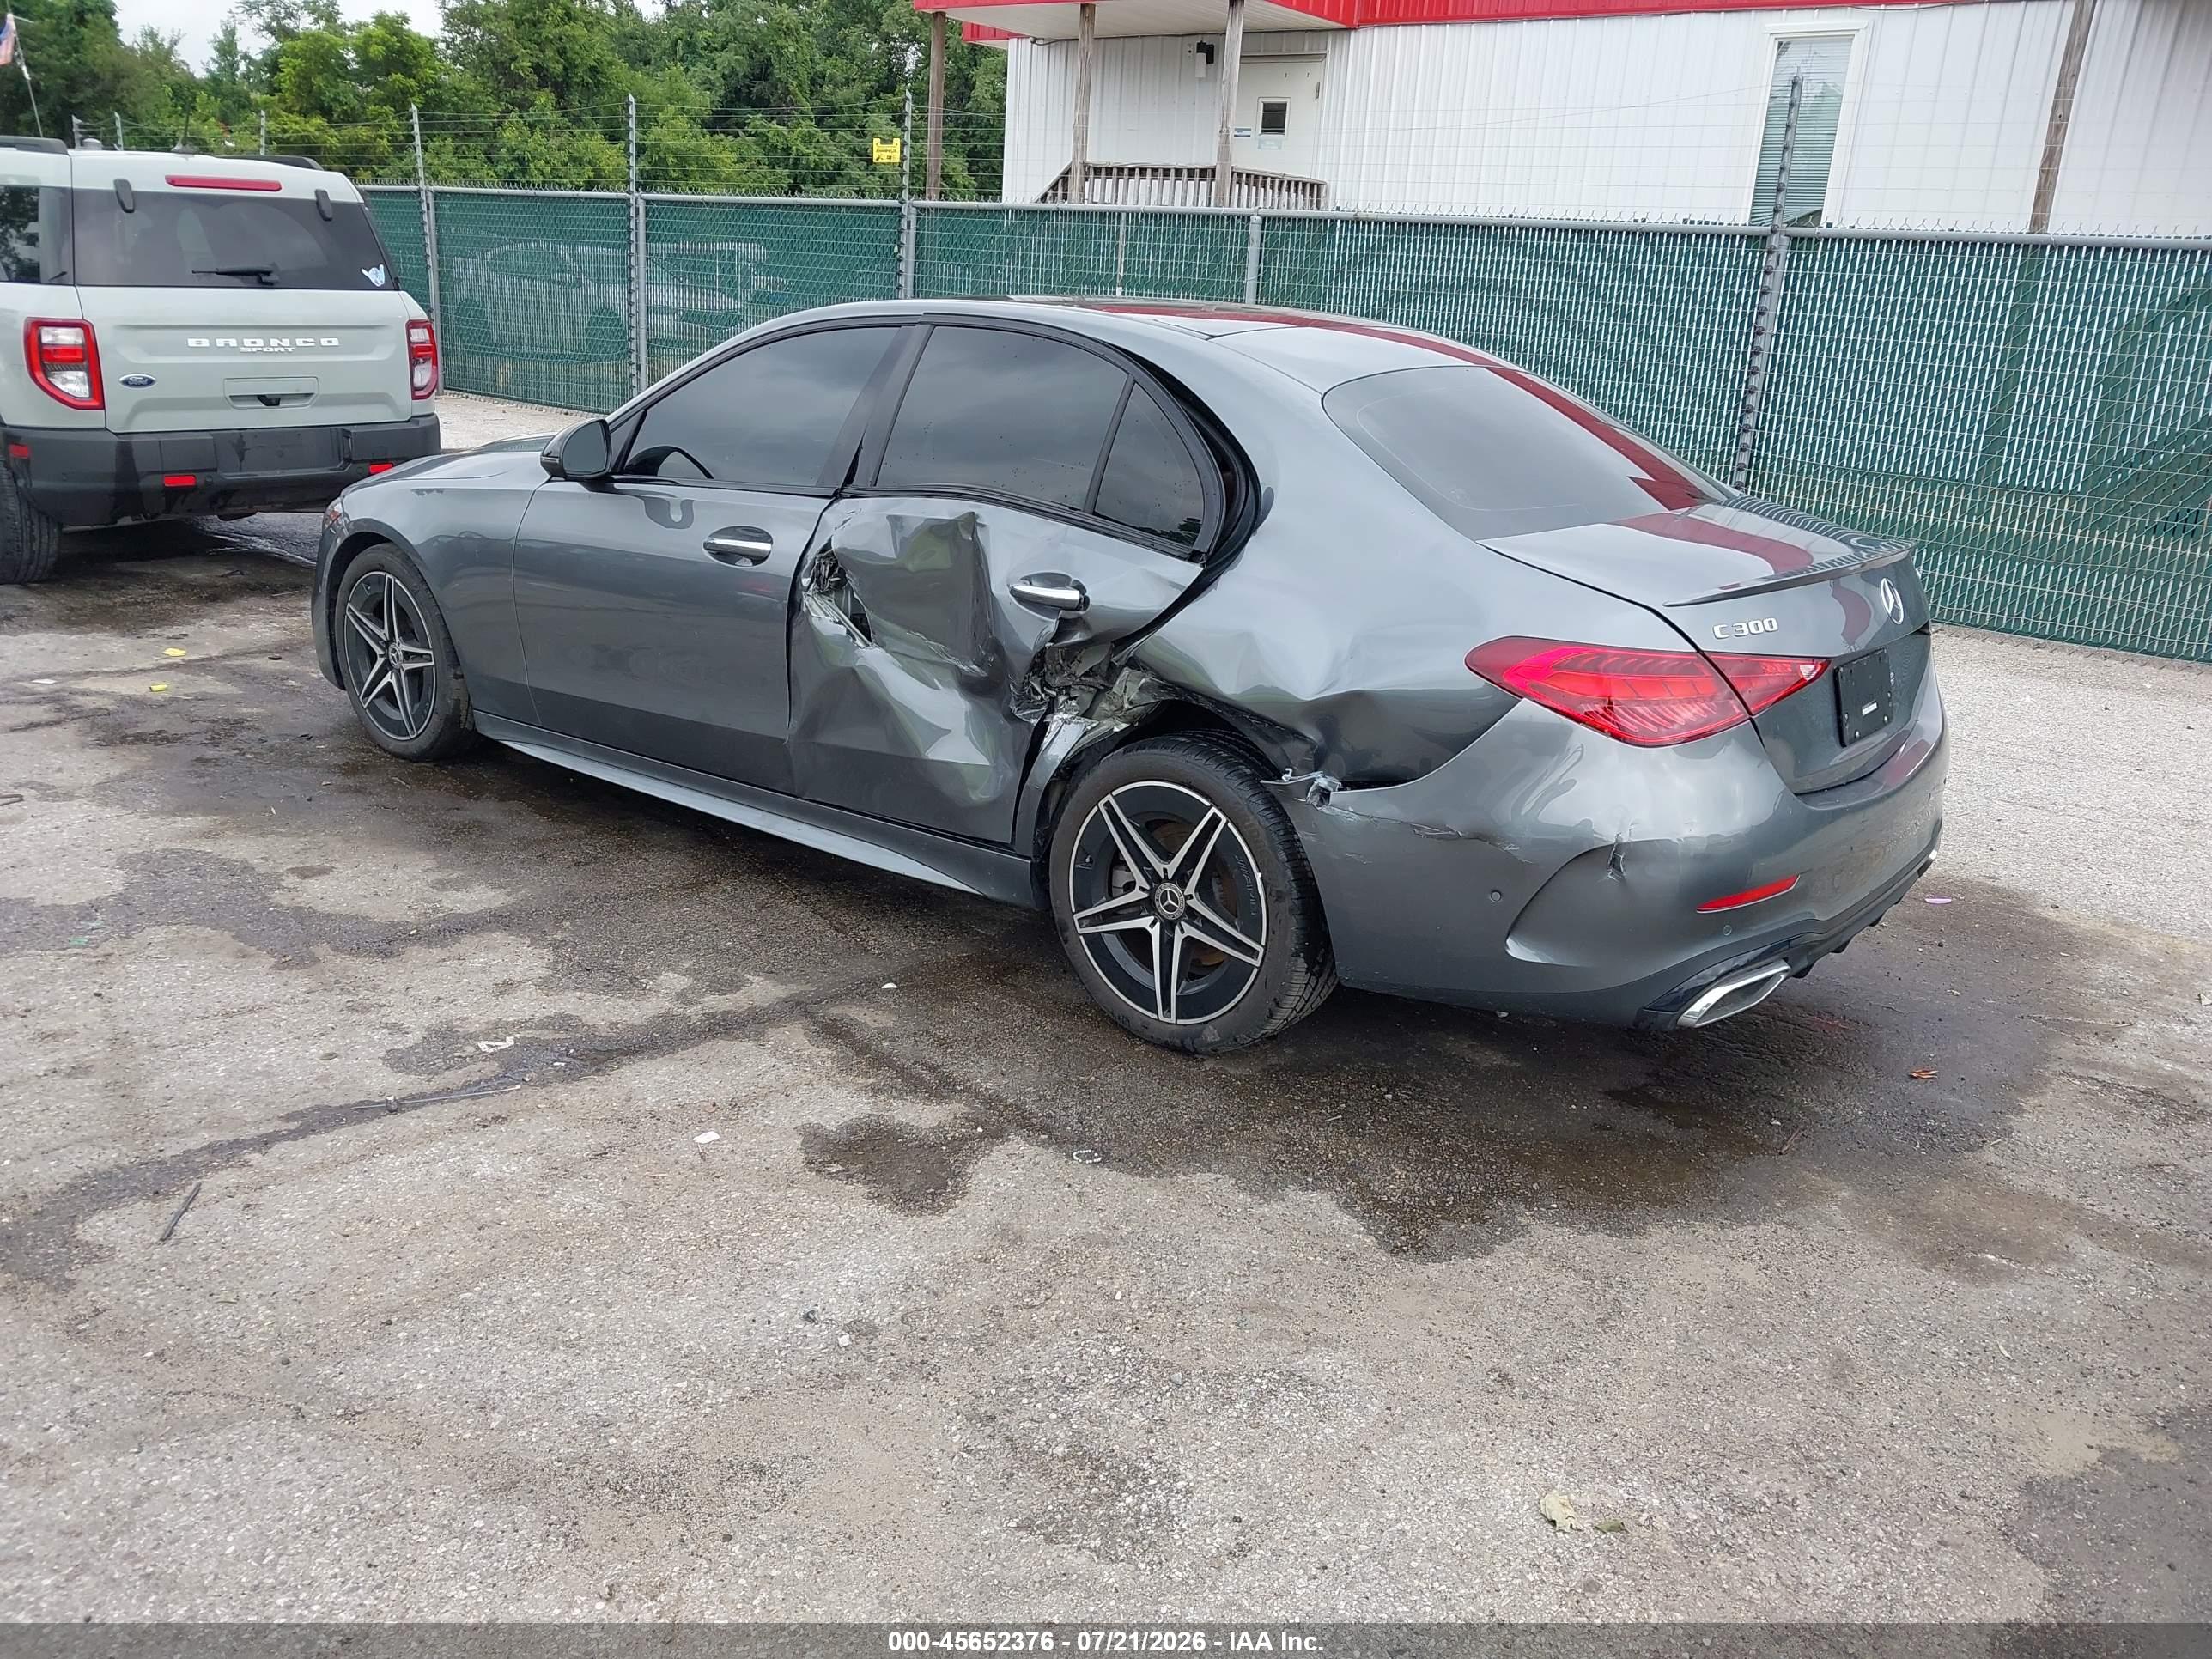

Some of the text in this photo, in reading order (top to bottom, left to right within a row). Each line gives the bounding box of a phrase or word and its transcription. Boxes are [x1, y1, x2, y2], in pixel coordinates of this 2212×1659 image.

[187, 337, 340, 348] BRONCO
[1713, 617, 1779, 639] C 300
